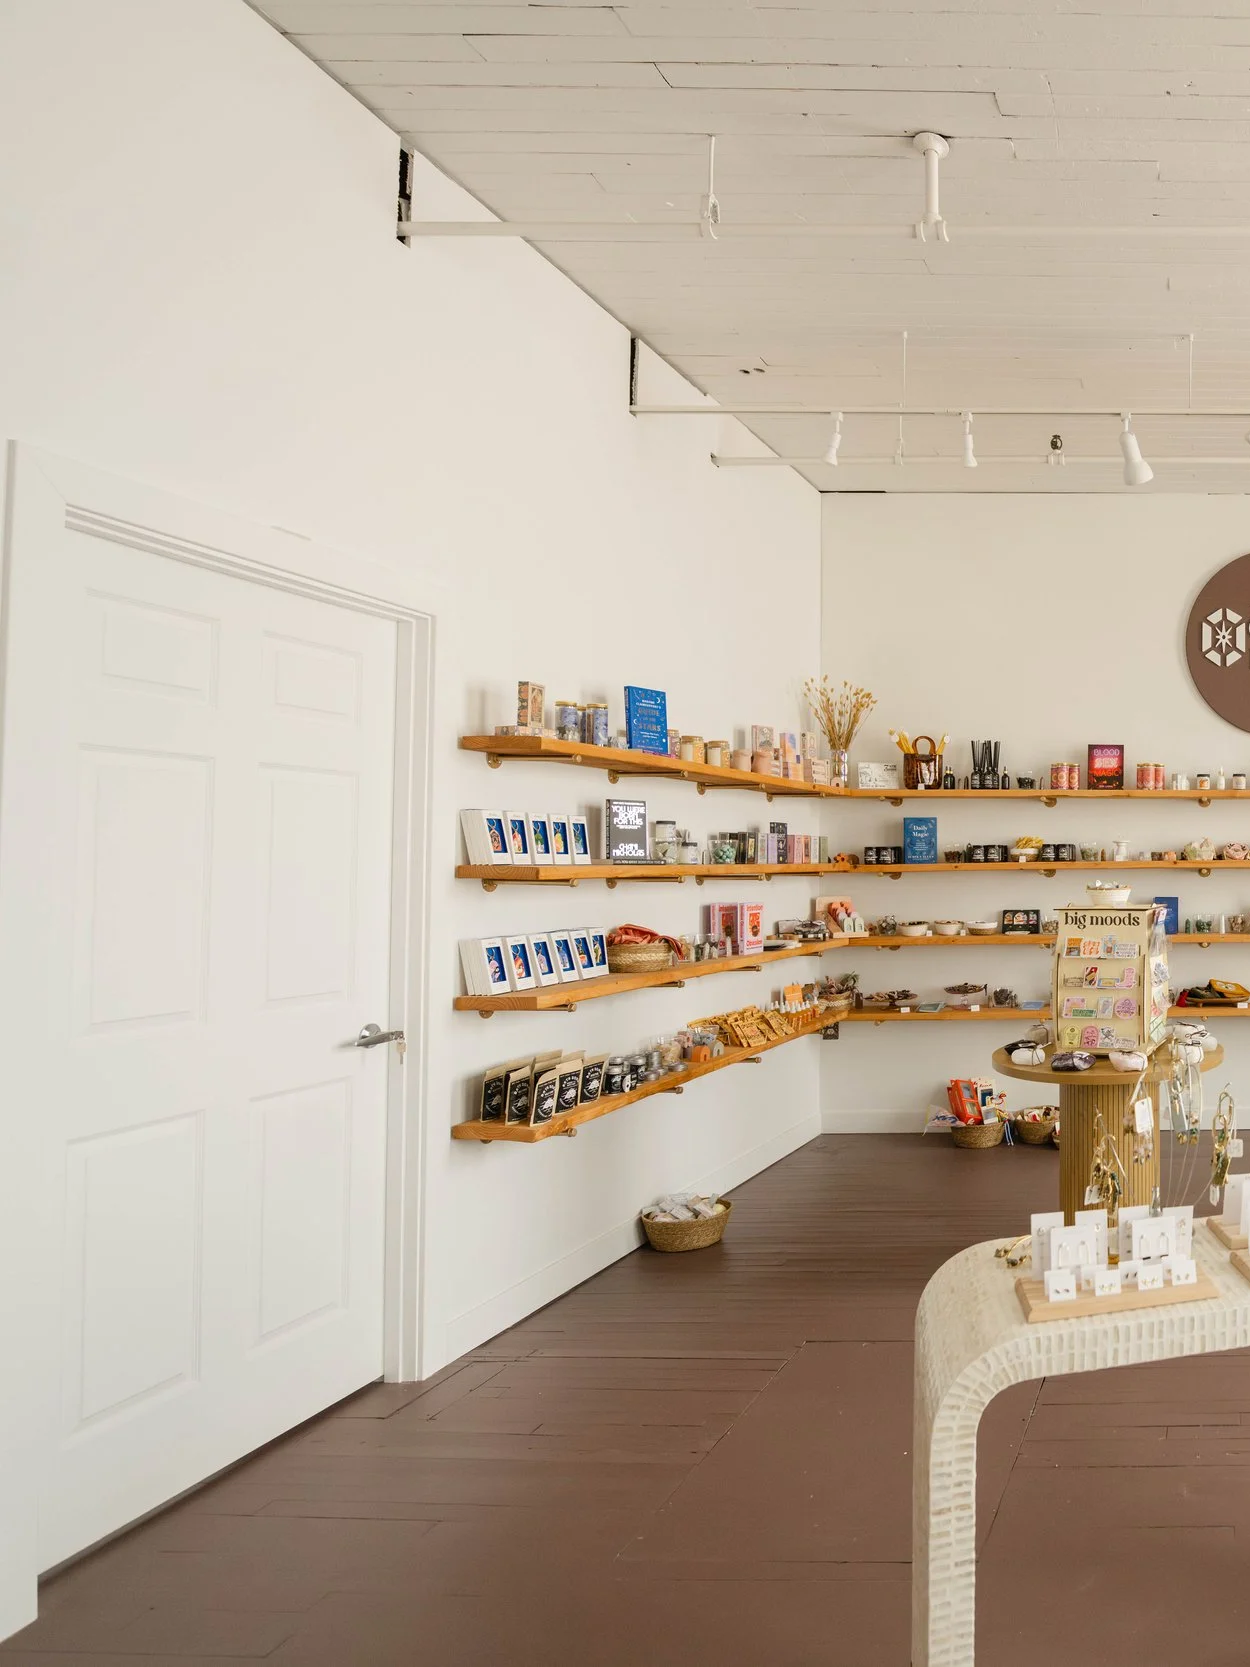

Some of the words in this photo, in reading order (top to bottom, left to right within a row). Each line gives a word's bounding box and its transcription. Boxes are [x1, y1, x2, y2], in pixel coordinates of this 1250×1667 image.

[1093, 748, 1120, 756] BLOOD
[1093, 768, 1120, 777] MAGIC
[611, 805, 627, 813] YOU
[627, 806, 646, 814] WERE
[613, 817, 628, 825] FOR
[628, 818, 644, 826] THIS
[913, 824, 929, 832] Daily
[612, 849, 645, 857] NICHOLAS
[746, 904, 764, 912] Intention
[1064, 912, 1087, 930] big
[1090, 912, 1141, 927] moods
